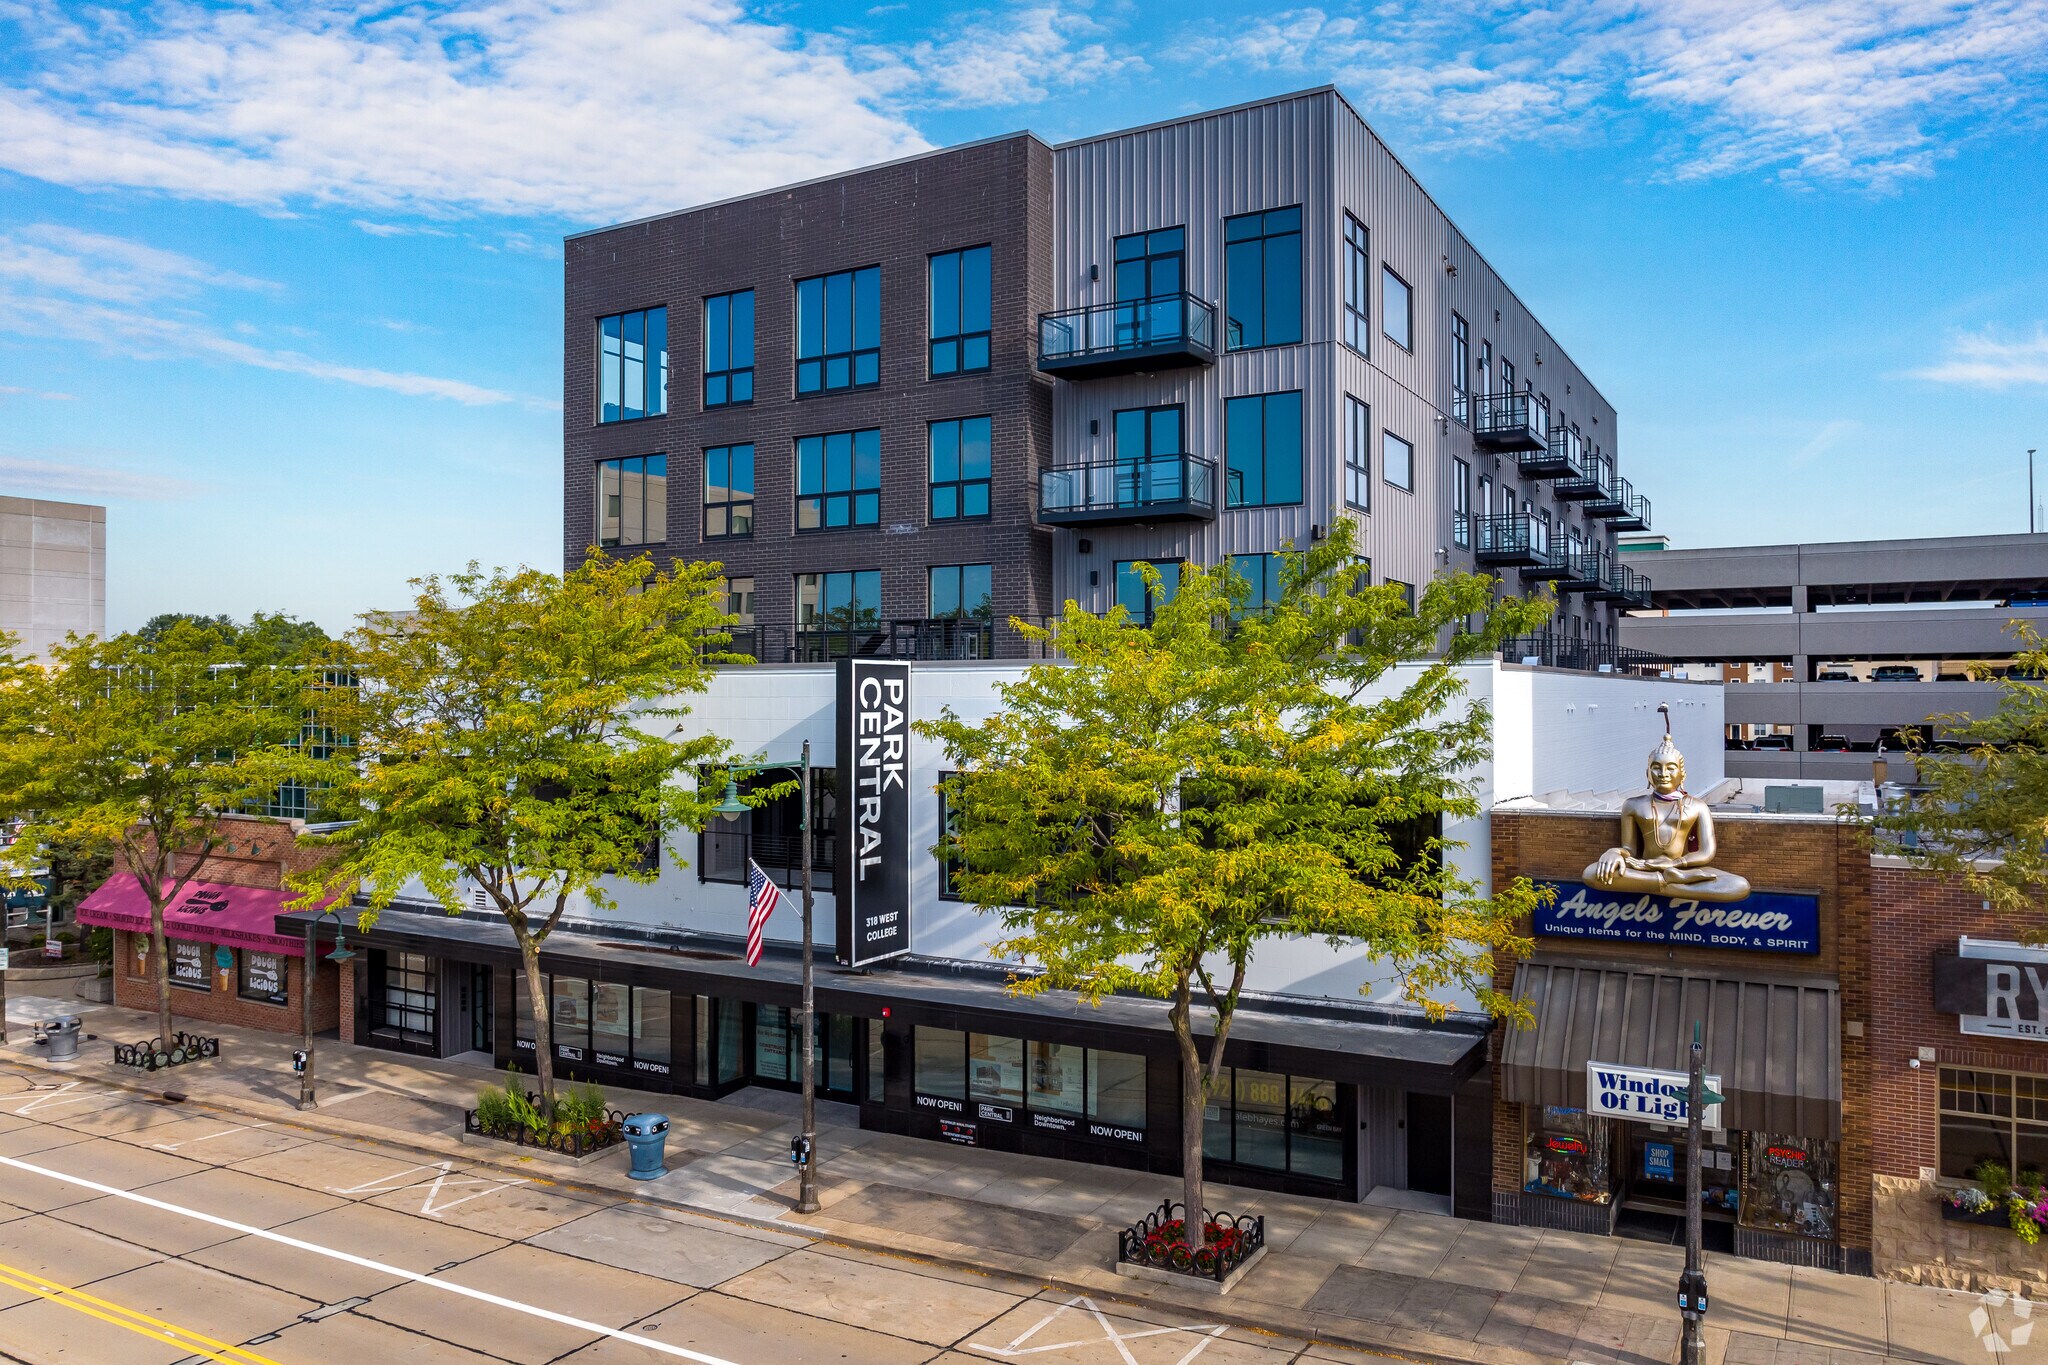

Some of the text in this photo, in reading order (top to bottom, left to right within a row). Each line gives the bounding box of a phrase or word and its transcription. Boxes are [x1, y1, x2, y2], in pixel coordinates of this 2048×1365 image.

[882, 679, 904, 792] PARK
[859, 676, 882, 881] CENTRAL
[193, 890, 223, 900] DOUGH
[1556, 888, 1793, 931] Angels Forever
[866, 911, 898, 927] 318 WEST
[90, 910, 108, 920] CREAM
[112, 914, 135, 924] SHAVED
[171, 921, 193, 932] COOKIE
[194, 924, 215, 935] DOUGH
[220, 927, 260, 943] MILKSHAKES
[267, 936, 305, 949] SMOOTHIES
[866, 926, 897, 942] COLLEGE
[1545, 923, 1809, 949] Unique Items for the MIND, BODY, & SPIRIT
[177, 944, 201, 957] DOUGH
[251, 954, 277, 969] DOUGH
[2018, 1024, 2041, 1035] EST.
[516, 1039, 530, 1050] NOW
[596, 1053, 624, 1064] Neighborhood
[633, 1060, 670, 1075] NOW OPEN!
[916, 1096, 962, 1112] NOW OPEN!
[980, 1105, 994, 1113] PARK
[1600, 1091, 1707, 1121] Of Ligh
[980, 1110, 1004, 1120] CENTRAL
[1034, 1113, 1075, 1127] Neighborhood
[1034, 1120, 1067, 1131] Downtown.
[1090, 1124, 1142, 1142] NOW OPEN!
[1545, 1137, 1587, 1155] Jewelry
[1651, 1148, 1669, 1158] SHOP
[1768, 1147, 1807, 1161] PSYCHIC
[1649, 1157, 1671, 1168] SMALL
[1769, 1156, 1805, 1168] READER
